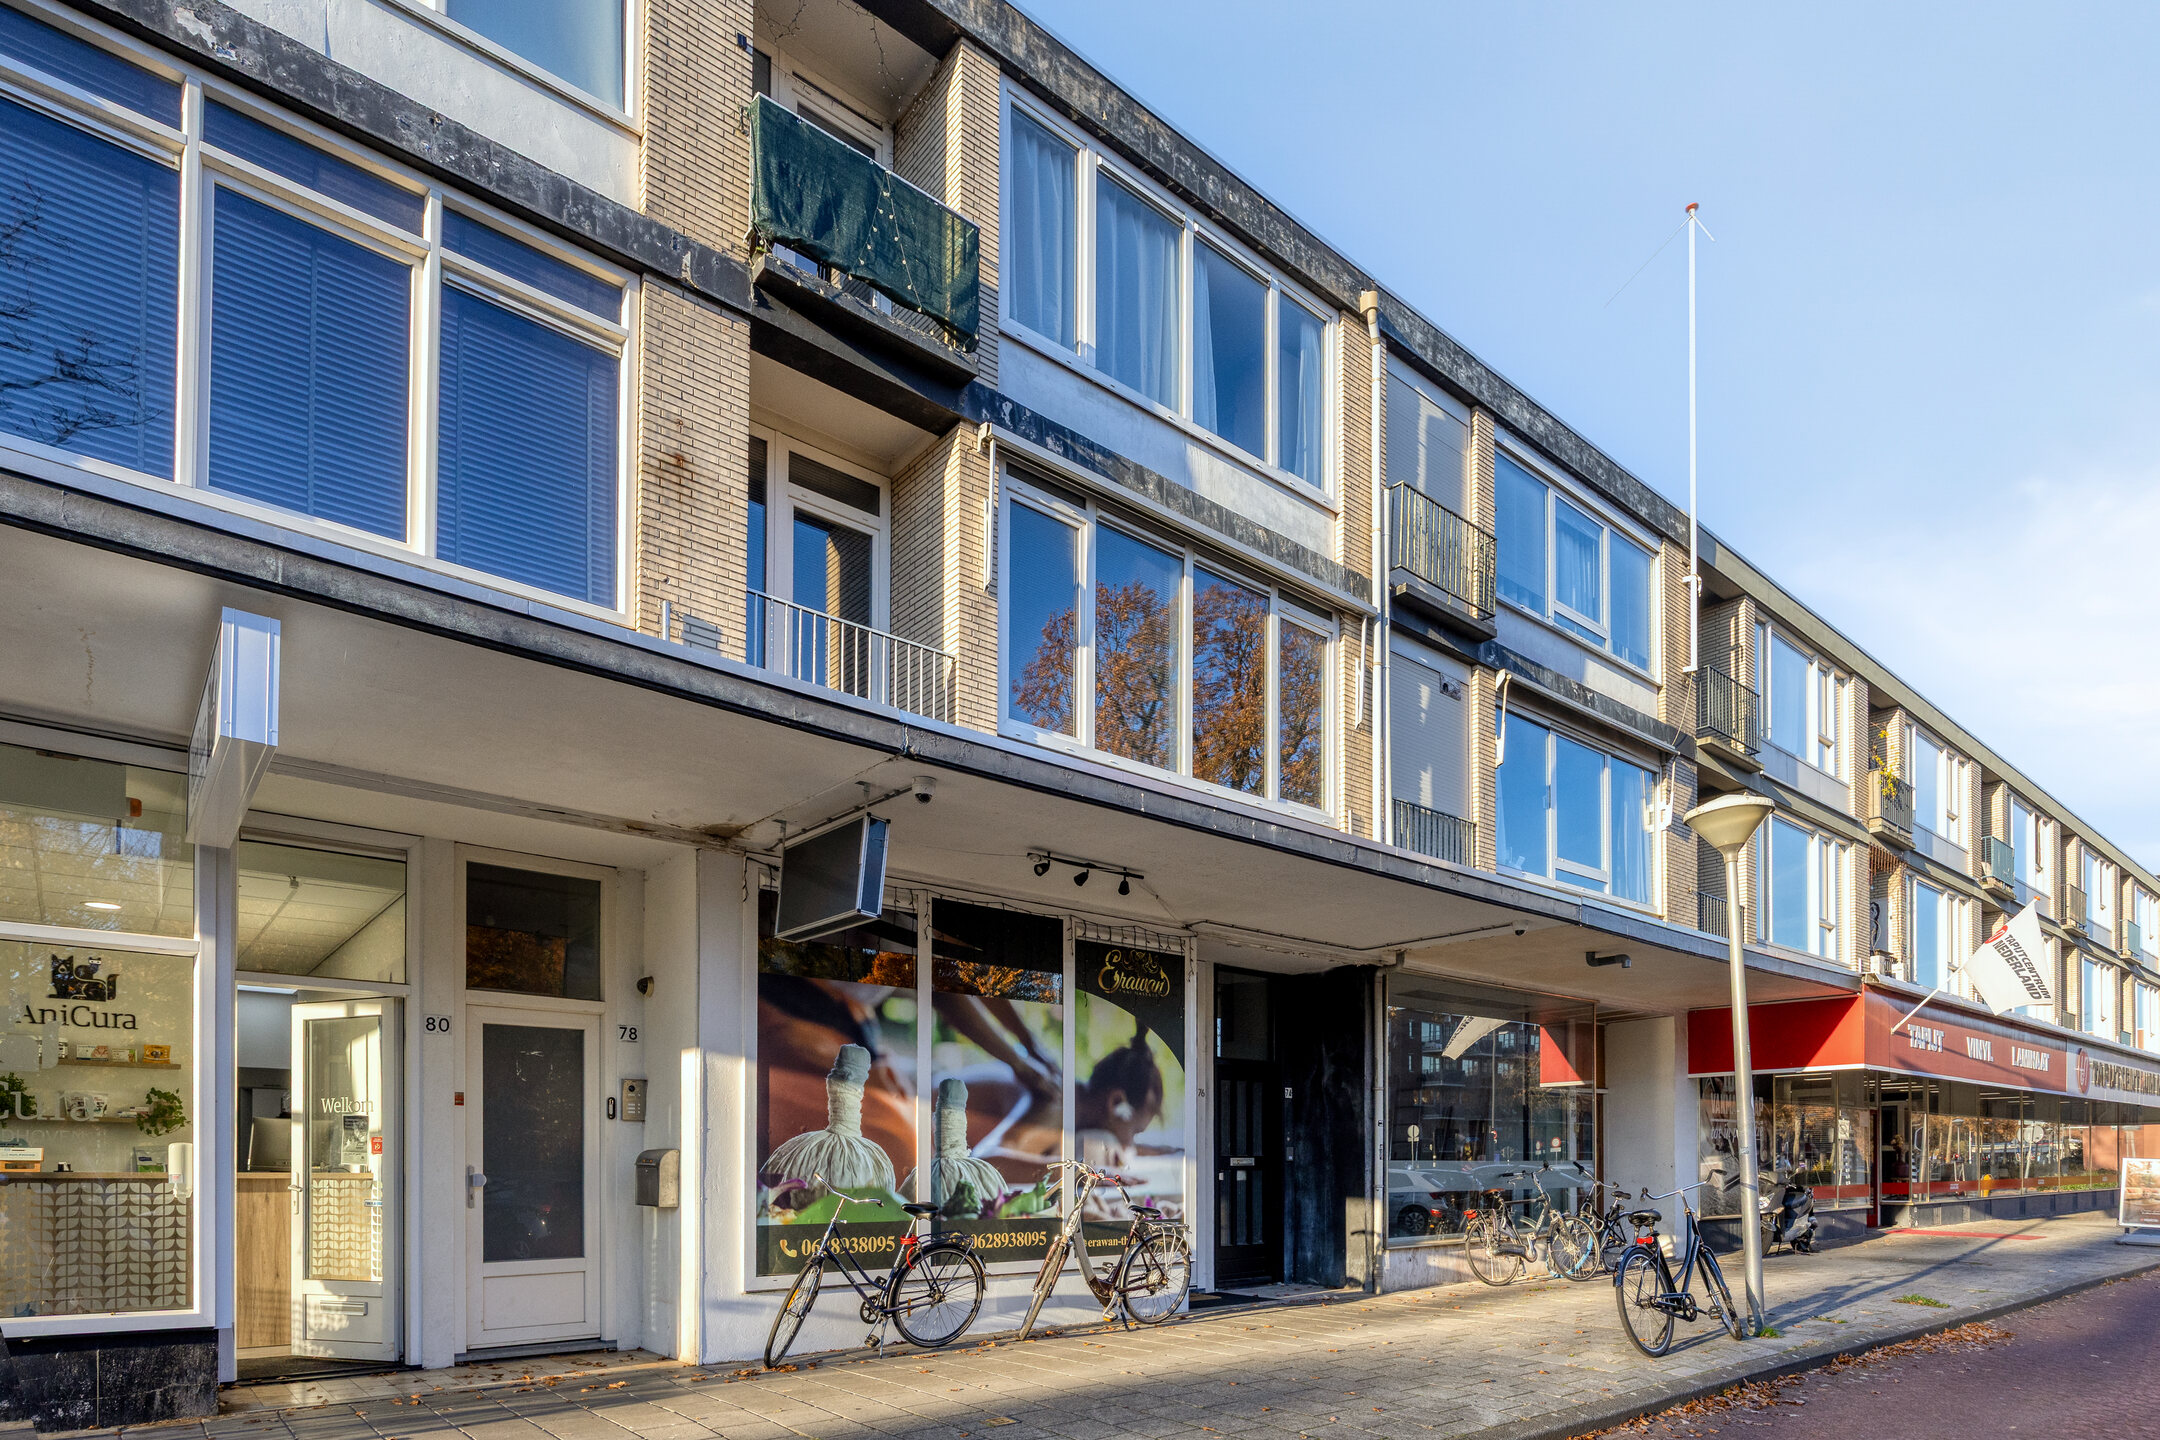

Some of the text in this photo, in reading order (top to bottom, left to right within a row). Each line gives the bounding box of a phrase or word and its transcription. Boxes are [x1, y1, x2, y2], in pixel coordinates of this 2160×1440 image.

[1098, 949, 1170, 998] Erawan
[1993, 940, 2042, 1000] NEDERLAND
[15, 1004, 138, 1030] AniCura
[425, 1017, 450, 1032] 80
[619, 1026, 638, 1041] 78
[1908, 1023, 1945, 1053] TAPIJT
[1966, 1036, 1994, 1062] VINYL
[2011, 1046, 2050, 1072] LAMINAAT
[321, 1096, 374, 1114] Welkom
[971, 1231, 1047, 1249] 0628938095
